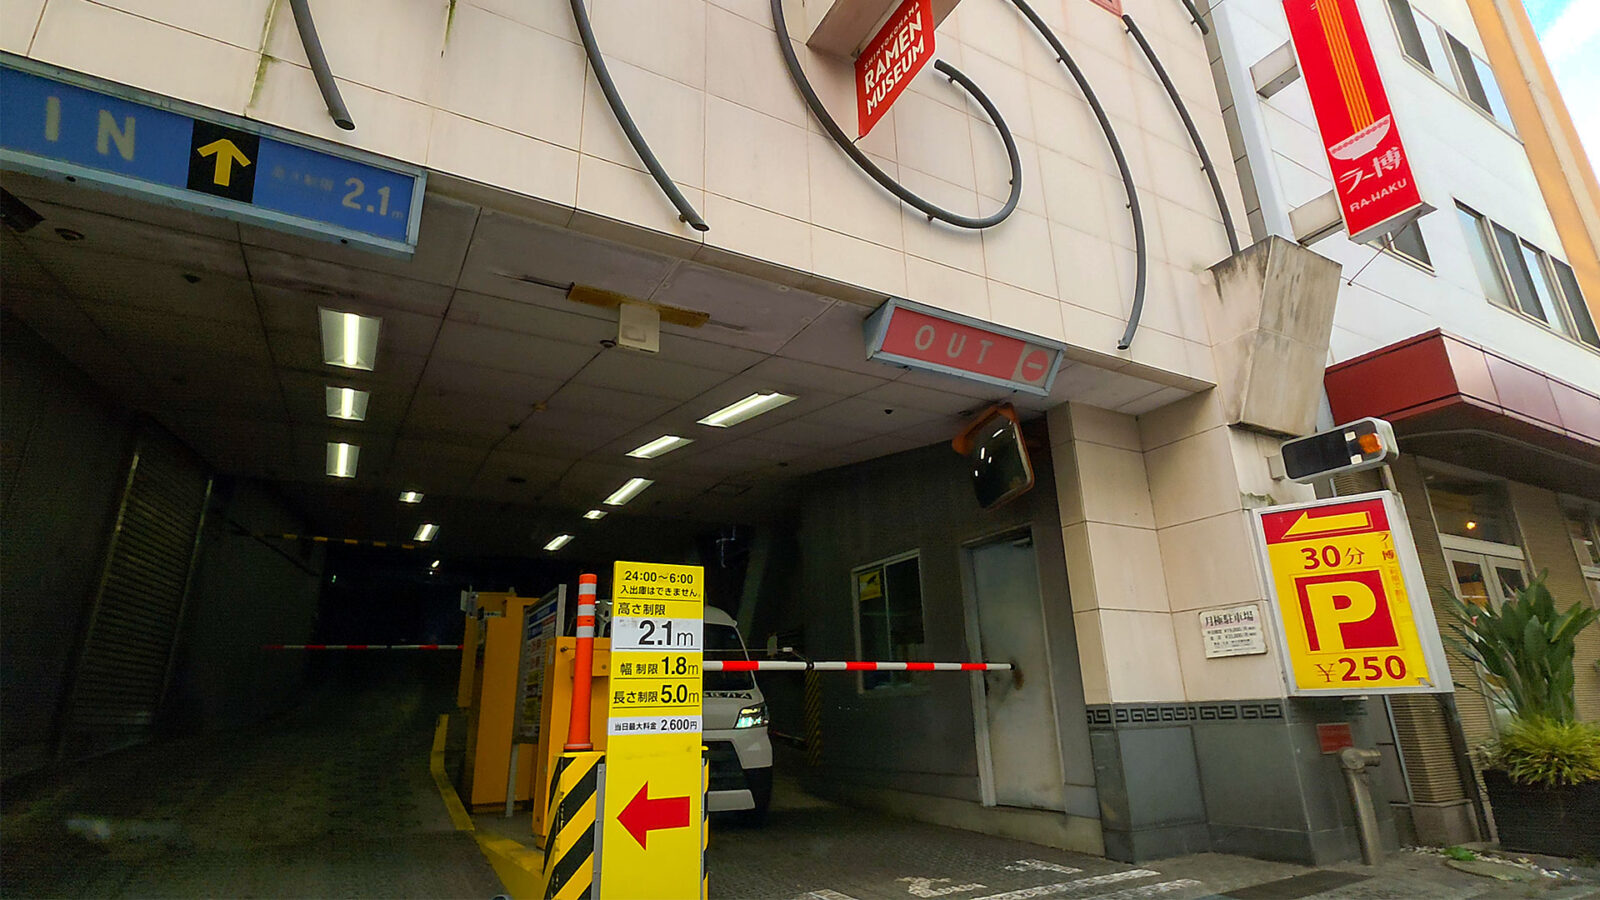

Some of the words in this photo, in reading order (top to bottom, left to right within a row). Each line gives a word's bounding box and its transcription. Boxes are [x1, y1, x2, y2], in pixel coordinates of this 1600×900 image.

[864, 2, 920, 71] SHINYOKOHAMA
[864, 10, 923, 95] RAMEN
[867, 35, 924, 116] MUSEUM
[45, 97, 136, 161] IN
[1339, 147, 1403, 195] ラー博
[914, 325, 994, 365] OUT
[1301, 545, 1365, 570] 30分
[617, 602, 666, 616] 高さ制限
[1305, 580, 1377, 651] P
[638, 619, 694, 647] 2.1m
[661, 656, 699, 675] 1.8m
[613, 690, 658, 704] 長さ制限
[660, 684, 700, 704] 5.0m
